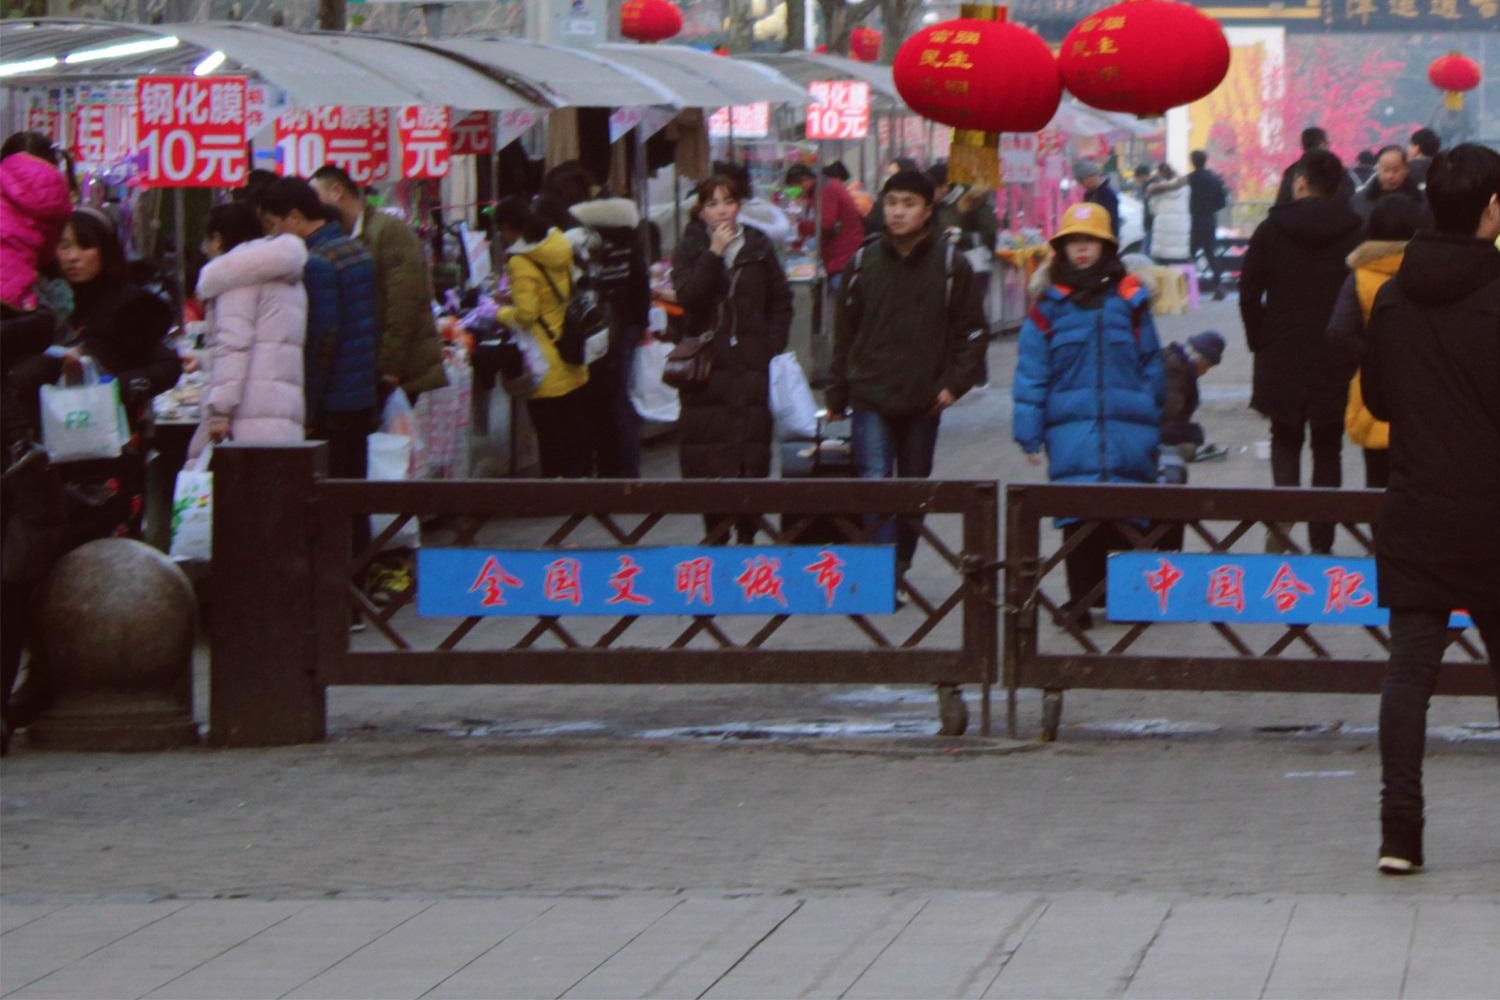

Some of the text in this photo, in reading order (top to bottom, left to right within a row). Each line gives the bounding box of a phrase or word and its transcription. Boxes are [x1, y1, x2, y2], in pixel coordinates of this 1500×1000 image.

[139, 81, 246, 126] 钢化膜
[806, 108, 867, 139] 10元
[138, 128, 246, 182] 10元
[277, 132, 372, 183] 10元
[469, 551, 846, 607] 全国文明城市
[1145, 558, 1374, 615] 中国合肥
